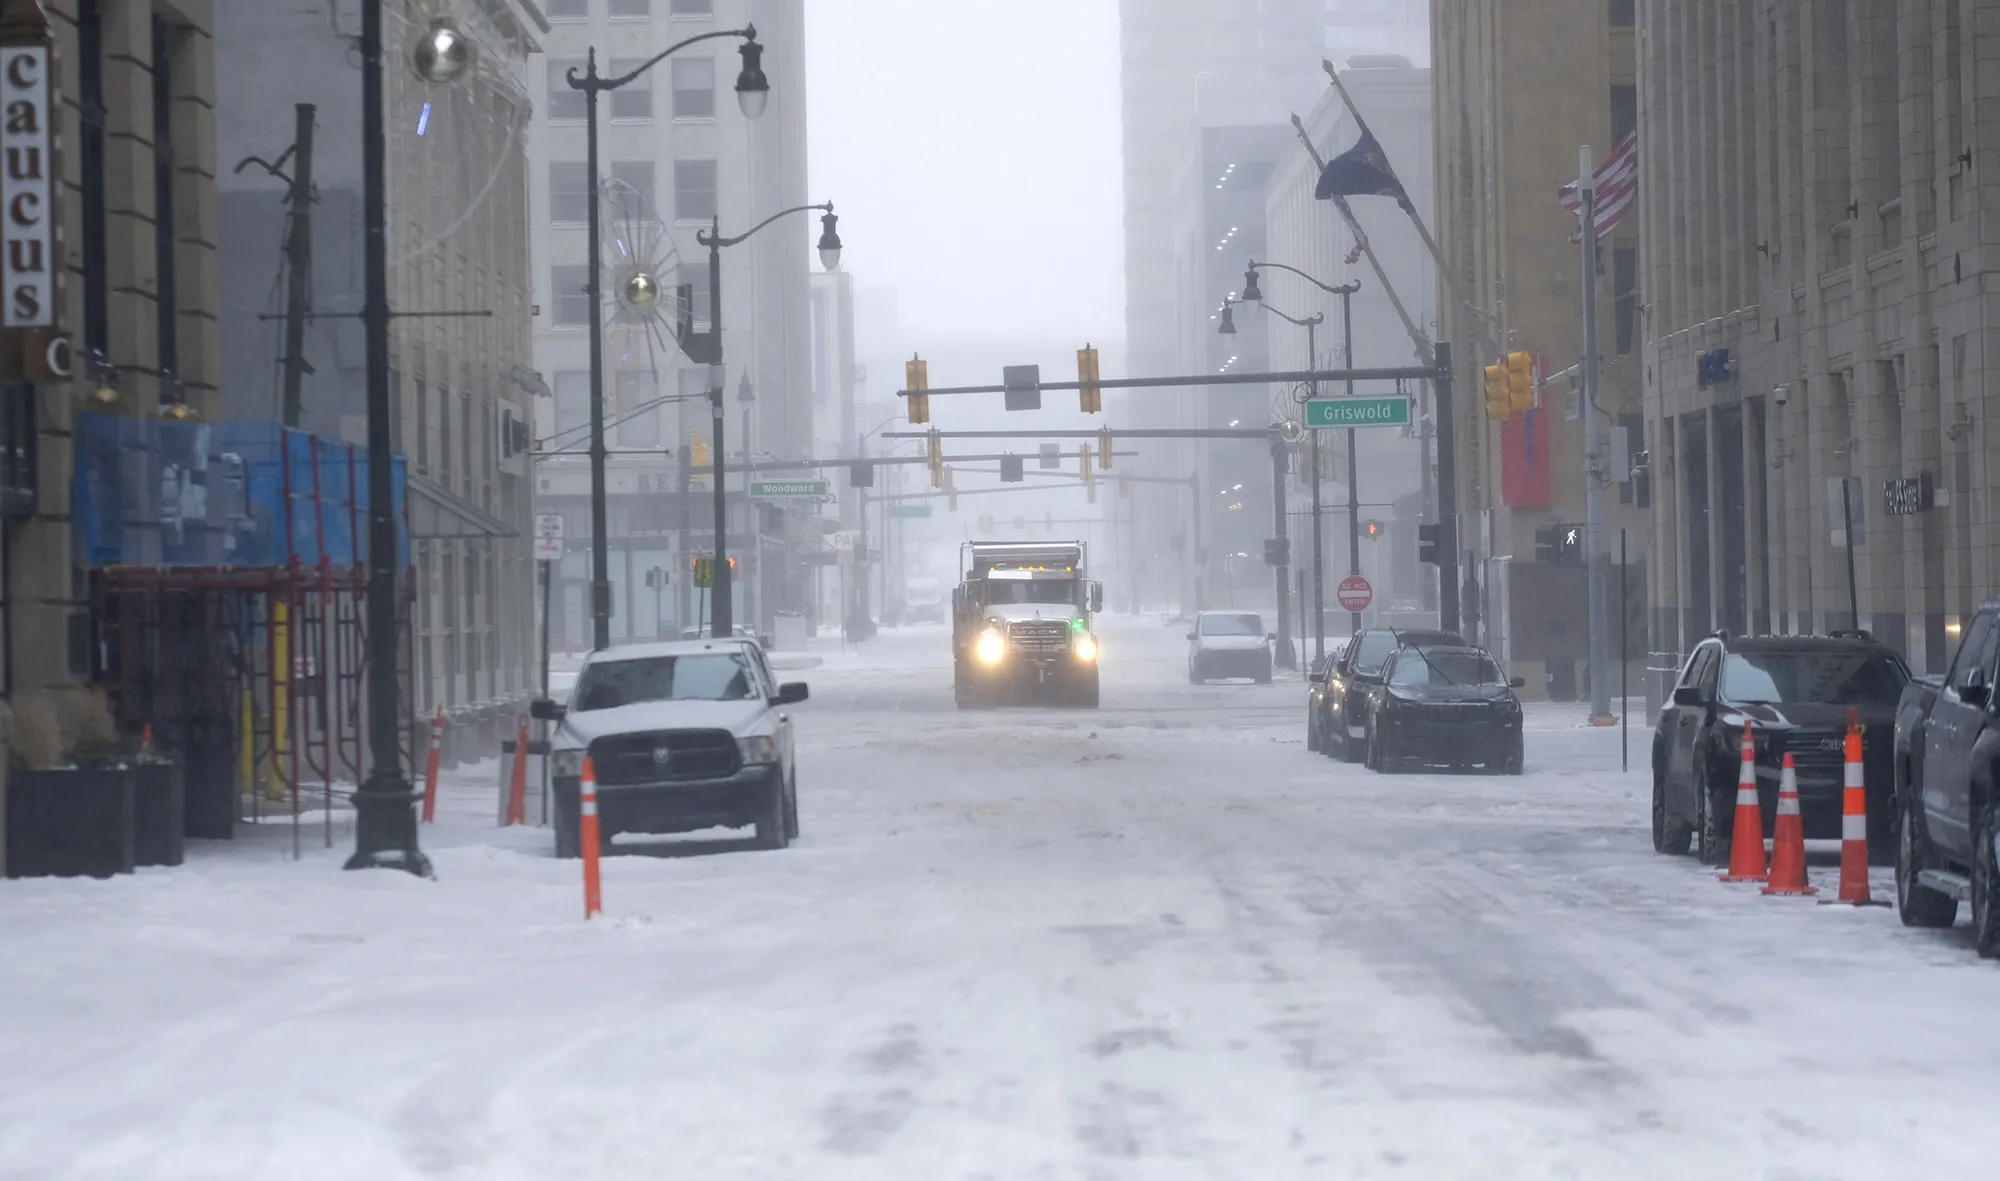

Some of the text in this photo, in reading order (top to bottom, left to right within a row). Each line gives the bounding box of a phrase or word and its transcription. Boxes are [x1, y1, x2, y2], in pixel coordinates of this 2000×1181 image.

[6, 54, 44, 320] caucus
[1324, 404, 1391, 420] Griswold
[763, 484, 815, 493] Woodward
